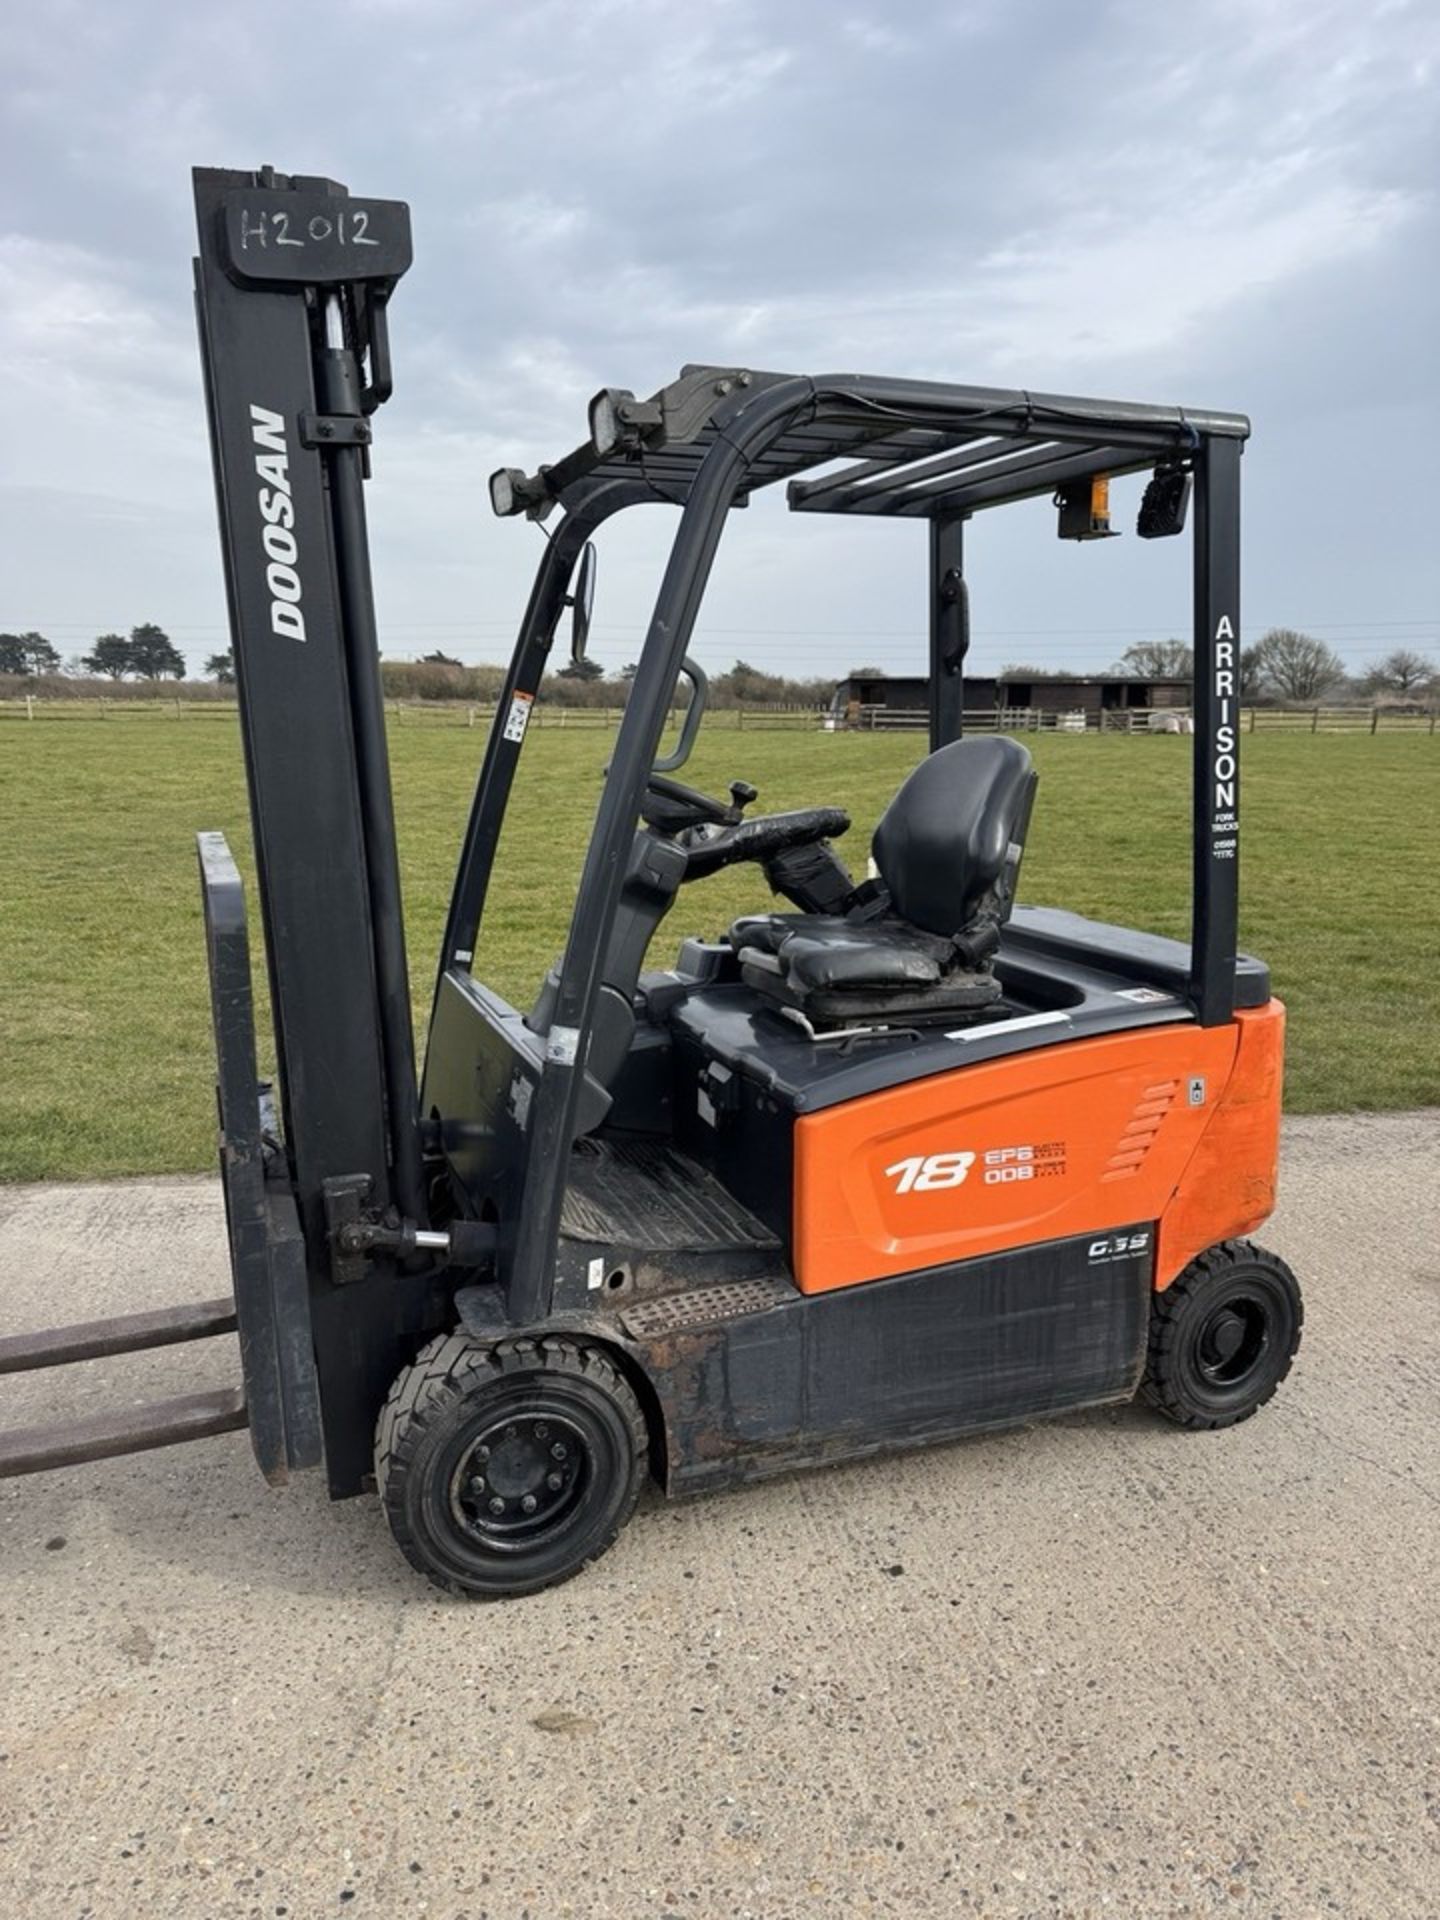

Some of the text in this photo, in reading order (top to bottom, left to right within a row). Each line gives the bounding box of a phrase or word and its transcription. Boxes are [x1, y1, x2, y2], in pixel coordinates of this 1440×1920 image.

[250, 403, 307, 643] DOOSAN
[1215, 615, 1235, 808] ARRISON
[885, 1151, 976, 1194] 18
